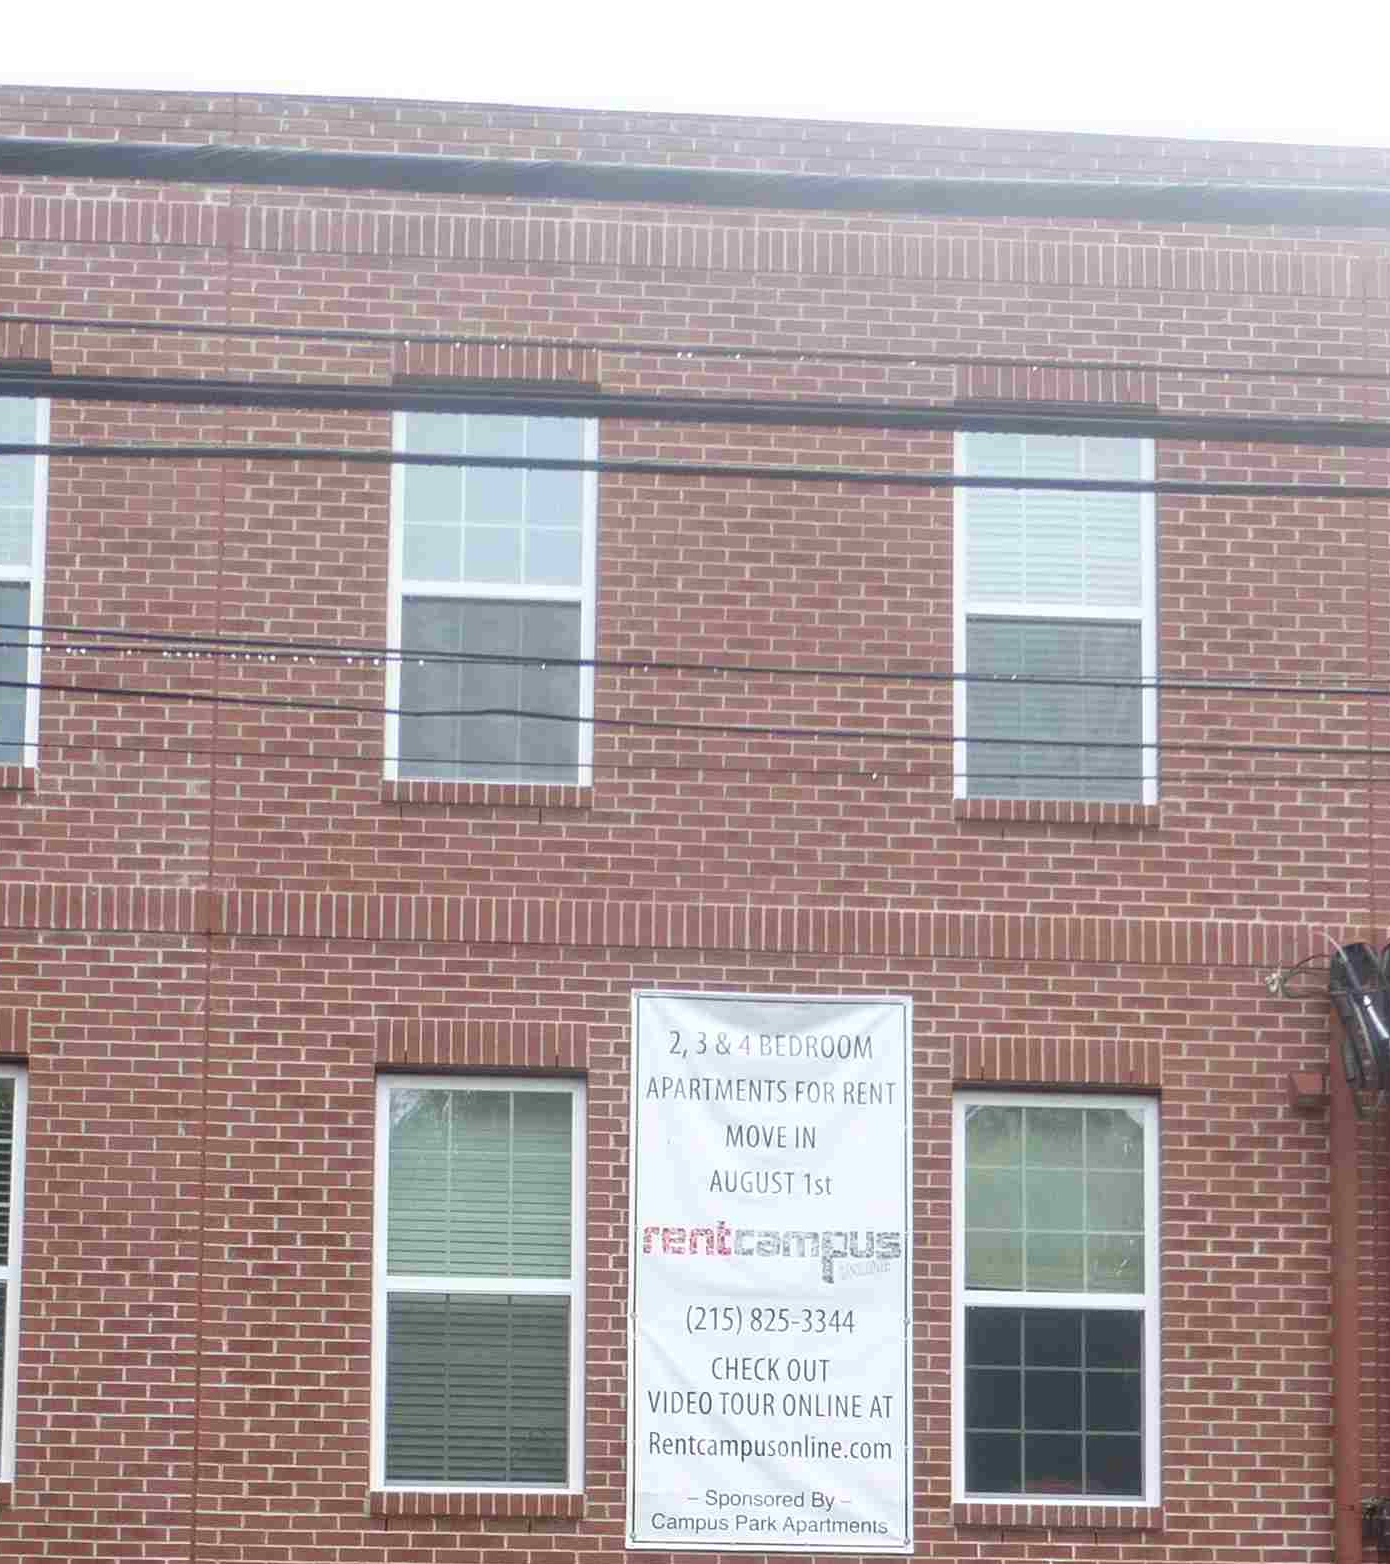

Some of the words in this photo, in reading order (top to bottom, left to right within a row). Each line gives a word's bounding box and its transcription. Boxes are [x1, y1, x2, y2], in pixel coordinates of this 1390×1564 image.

[668, 1030, 688, 1059] 2,
[697, 1031, 707, 1055] 3
[715, 1031, 731, 1056] &
[738, 1034, 751, 1056] 4
[759, 1034, 874, 1059] BEDROOM
[646, 1076, 788, 1103] APARTMENTS
[795, 1081, 835, 1104] FOR
[842, 1081, 897, 1105] RENT
[725, 1124, 787, 1149] MOVE
[795, 1126, 817, 1149] IN
[709, 1169, 795, 1194] AUGUST
[803, 1173, 833, 1196] 1st
[686, 1305, 743, 1335] (215)
[750, 1307, 855, 1334] 825-3344
[711, 1357, 780, 1382] CHECK
[787, 1358, 830, 1382] OUT
[648, 1390, 713, 1415] VIDEO
[721, 1391, 775, 1417] TOUR
[782, 1393, 862, 1418] ONLINE
[869, 1395, 894, 1418] AT
[649, 1431, 892, 1462] Rentcampusonline.com
[705, 1490, 805, 1509] Sponsored
[811, 1491, 835, 1511] By
[651, 1512, 729, 1533] Campus
[735, 1514, 777, 1532] Park
[782, 1516, 888, 1535] Apartments
